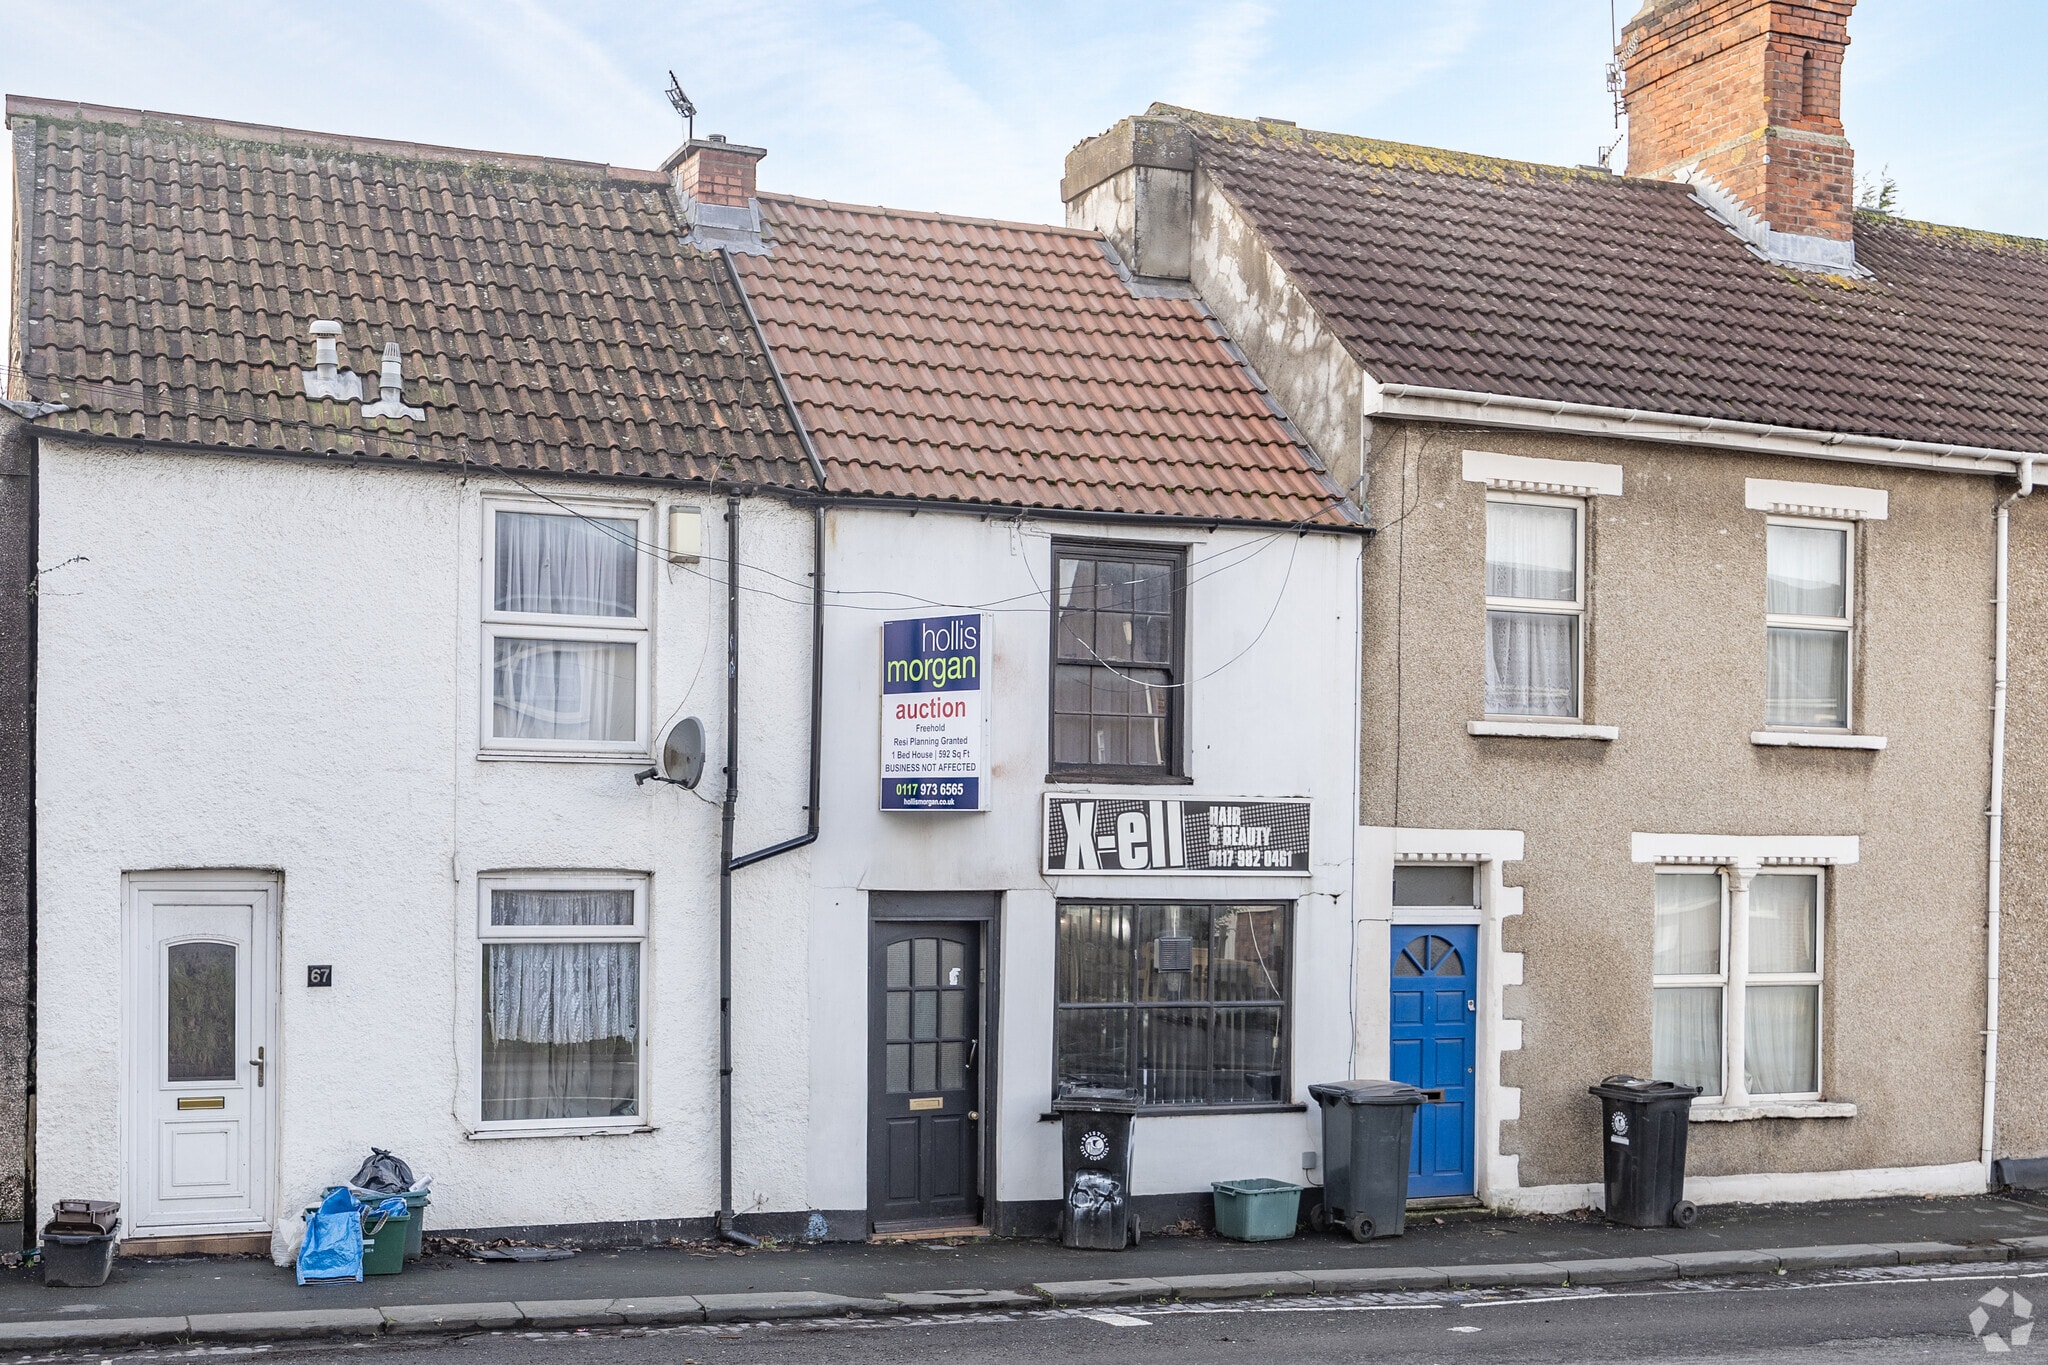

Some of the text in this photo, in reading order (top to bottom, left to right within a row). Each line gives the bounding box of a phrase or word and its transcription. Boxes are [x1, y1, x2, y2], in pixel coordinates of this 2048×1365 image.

[922, 620, 977, 652] hollis
[887, 656, 976, 688] morgan
[896, 697, 966, 719] auction
[916, 724, 945, 732] Freehold
[894, 736, 968, 747] Resi Planning Granted
[897, 751, 910, 759] Bed
[911, 751, 933, 759] House
[938, 750, 950, 758] 592
[952, 750, 961, 759] Sq
[963, 750, 970, 758] Ft
[885, 763, 976, 772] BUSINESS NOT AFFECTED
[896, 783, 963, 795] 0117 973 6565
[904, 798, 954, 807] hollismorgan.co.uk
[1209, 806, 1240, 825] HAIR
[1060, 800, 1186, 869] X-ell
[1209, 827, 1271, 846] & BEAUTY
[1209, 850, 1292, 867] 0117 982 0461
[311, 969, 330, 982] 67
[1081, 1131, 1108, 1142] BRISTOL
[1080, 1145, 1089, 1157] CITY
